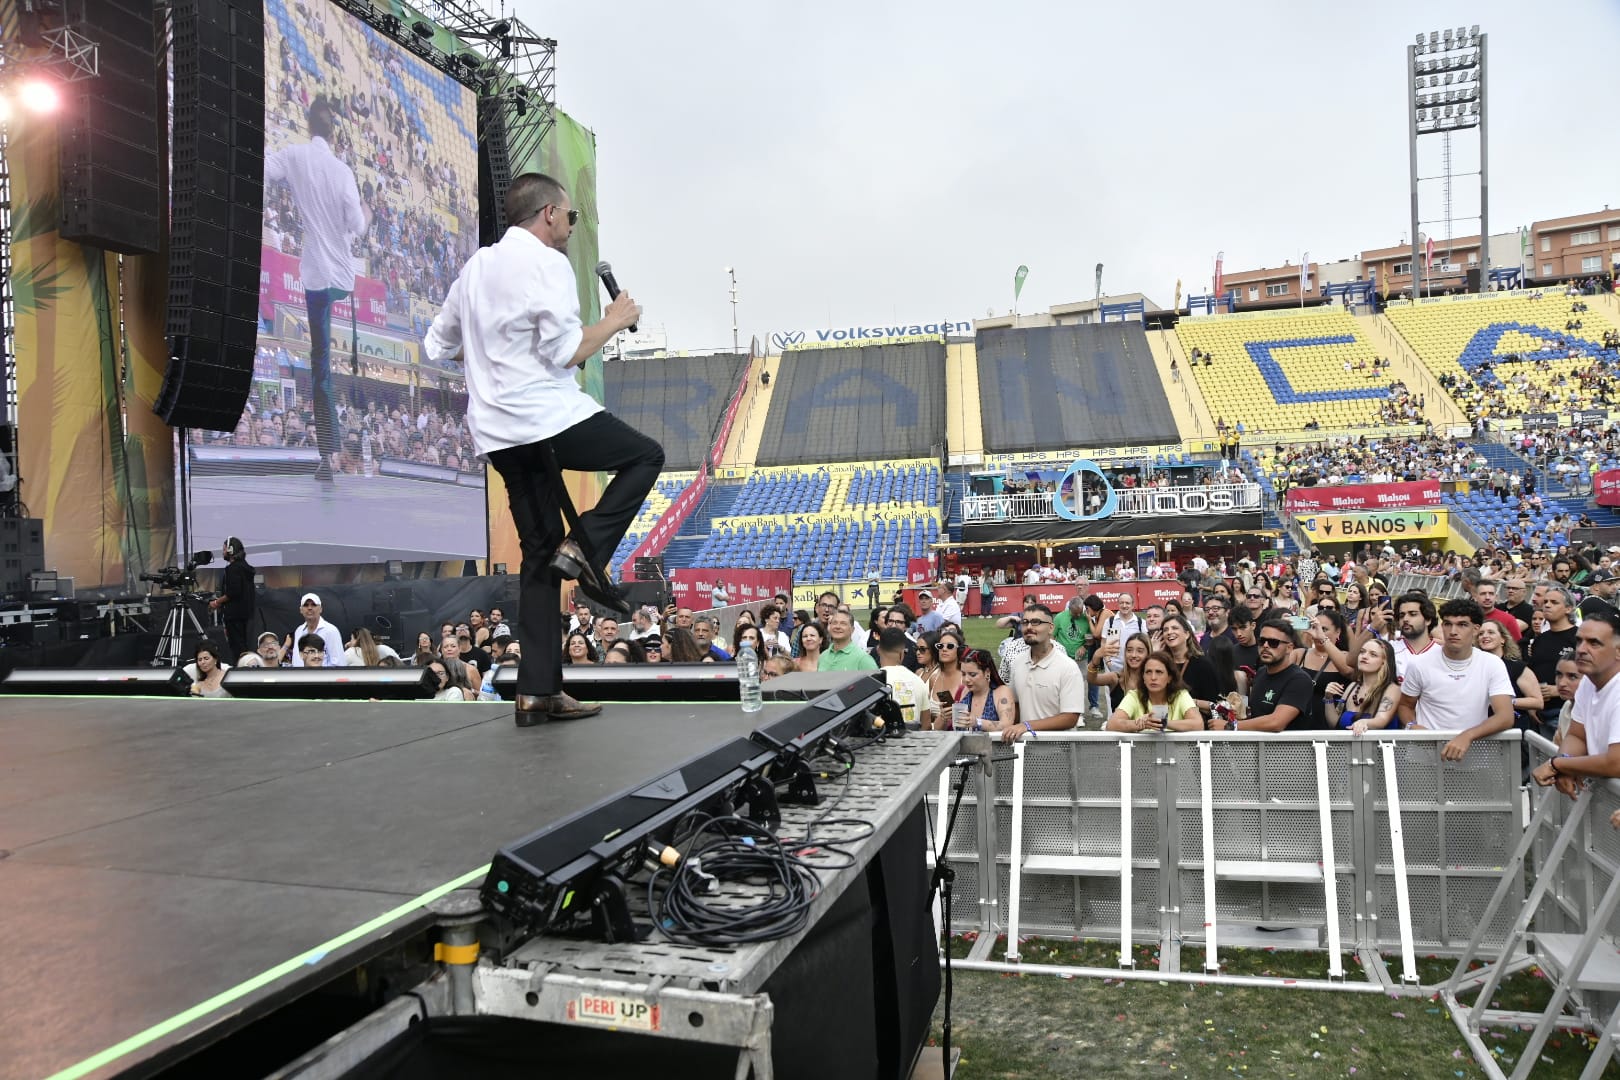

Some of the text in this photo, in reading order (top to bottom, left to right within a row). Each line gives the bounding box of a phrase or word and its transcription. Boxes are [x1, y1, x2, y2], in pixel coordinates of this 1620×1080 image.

[815, 320, 971, 341] Volkswagen
[1092, 448, 1116, 457] HPS
[1125, 447, 1148, 455] HPS
[1158, 444, 1183, 453] HPS
[992, 454, 1015, 462] HPS
[1022, 452, 1047, 460] HPS
[1056, 451, 1080, 459] HPS
[826, 464, 867, 473] CaixaBank
[892, 460, 933, 470] CaixaBank
[762, 468, 802, 476] CaixaBank
[1147, 490, 1234, 514] IQOS
[1332, 496, 1365, 506] Mahou
[1378, 493, 1410, 502] Mahou
[806, 514, 855, 524] CaixaBank
[884, 510, 934, 520] CaixaBank
[730, 517, 778, 528] CaixaBank
[1342, 515, 1406, 534] BAÑOS
[584, 998, 648, 1019] PERI UP
